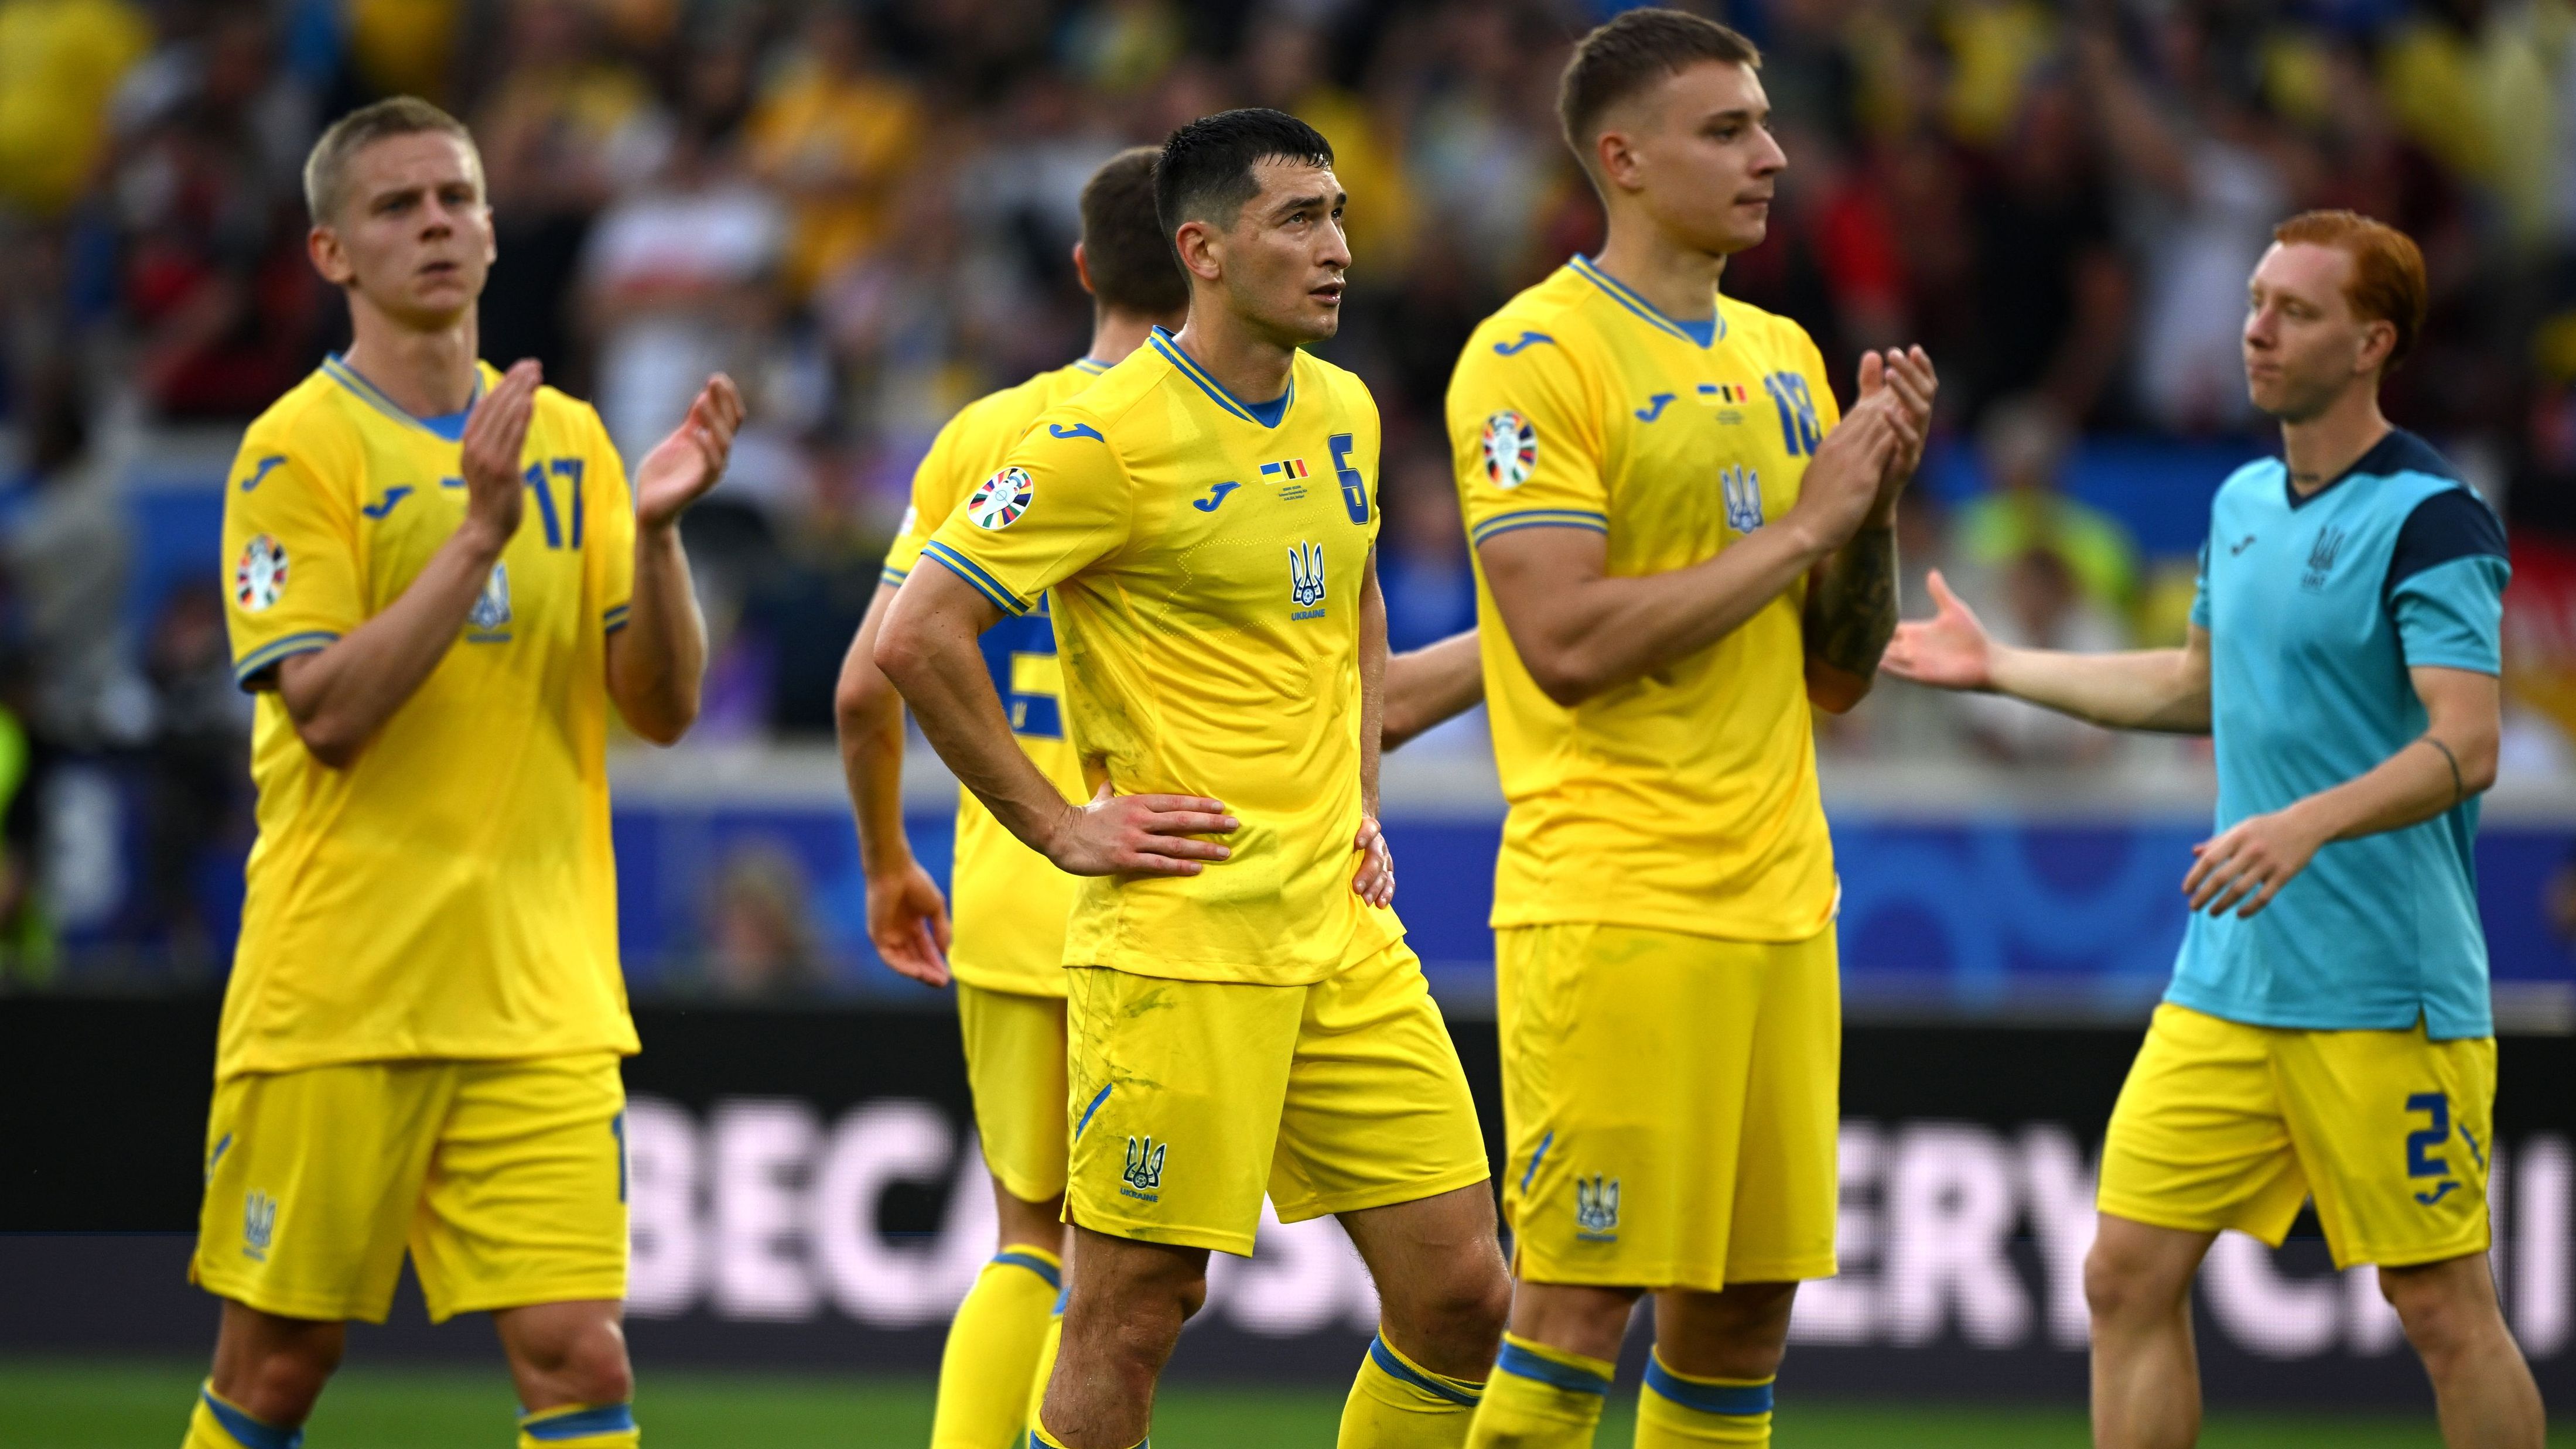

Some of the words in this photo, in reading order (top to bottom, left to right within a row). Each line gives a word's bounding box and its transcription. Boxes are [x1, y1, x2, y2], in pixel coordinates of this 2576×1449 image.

[1764, 370, 1824, 456] 18
[523, 459, 583, 549] 17
[1328, 433, 1371, 525] 6
[1291, 608, 1325, 621] UKRAINE
[2405, 1093, 2451, 1178] 2
[1119, 1186, 1159, 1203] UKRAINE
